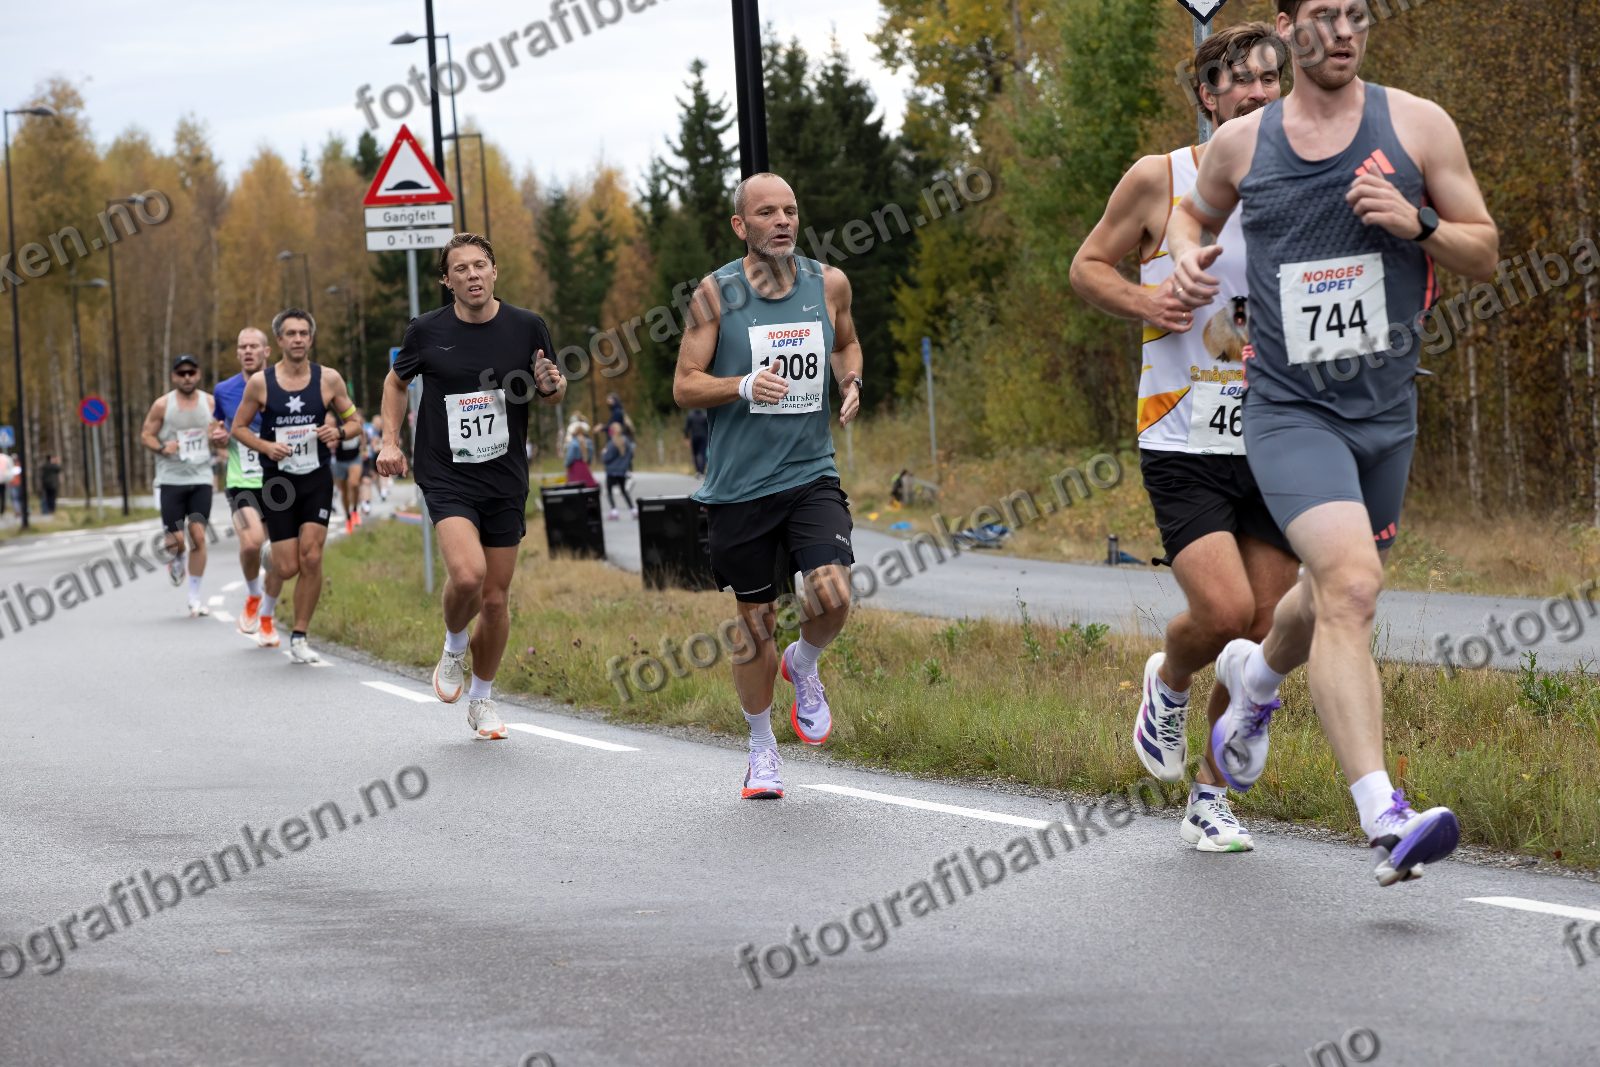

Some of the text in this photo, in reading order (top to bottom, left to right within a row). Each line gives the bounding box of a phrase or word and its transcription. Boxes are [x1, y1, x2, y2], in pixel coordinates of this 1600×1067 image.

[383, 210, 436, 224] Gangfelt
[387, 235, 396, 246] 0
[408, 234, 413, 245] 1
[416, 234, 434, 245] km
[1302, 264, 1364, 284] NORGES
[1308, 278, 1355, 294] LØPET
[1301, 299, 1368, 341] 744
[767, 329, 811, 340] NORGES
[771, 338, 805, 348] LØPET
[458, 396, 496, 406] NORGES
[782, 392, 820, 403] Aurskog
[462, 403, 489, 412] LØPET
[275, 414, 316, 425] SAYSKY
[1209, 405, 1243, 437] 46
[460, 413, 495, 439] 517
